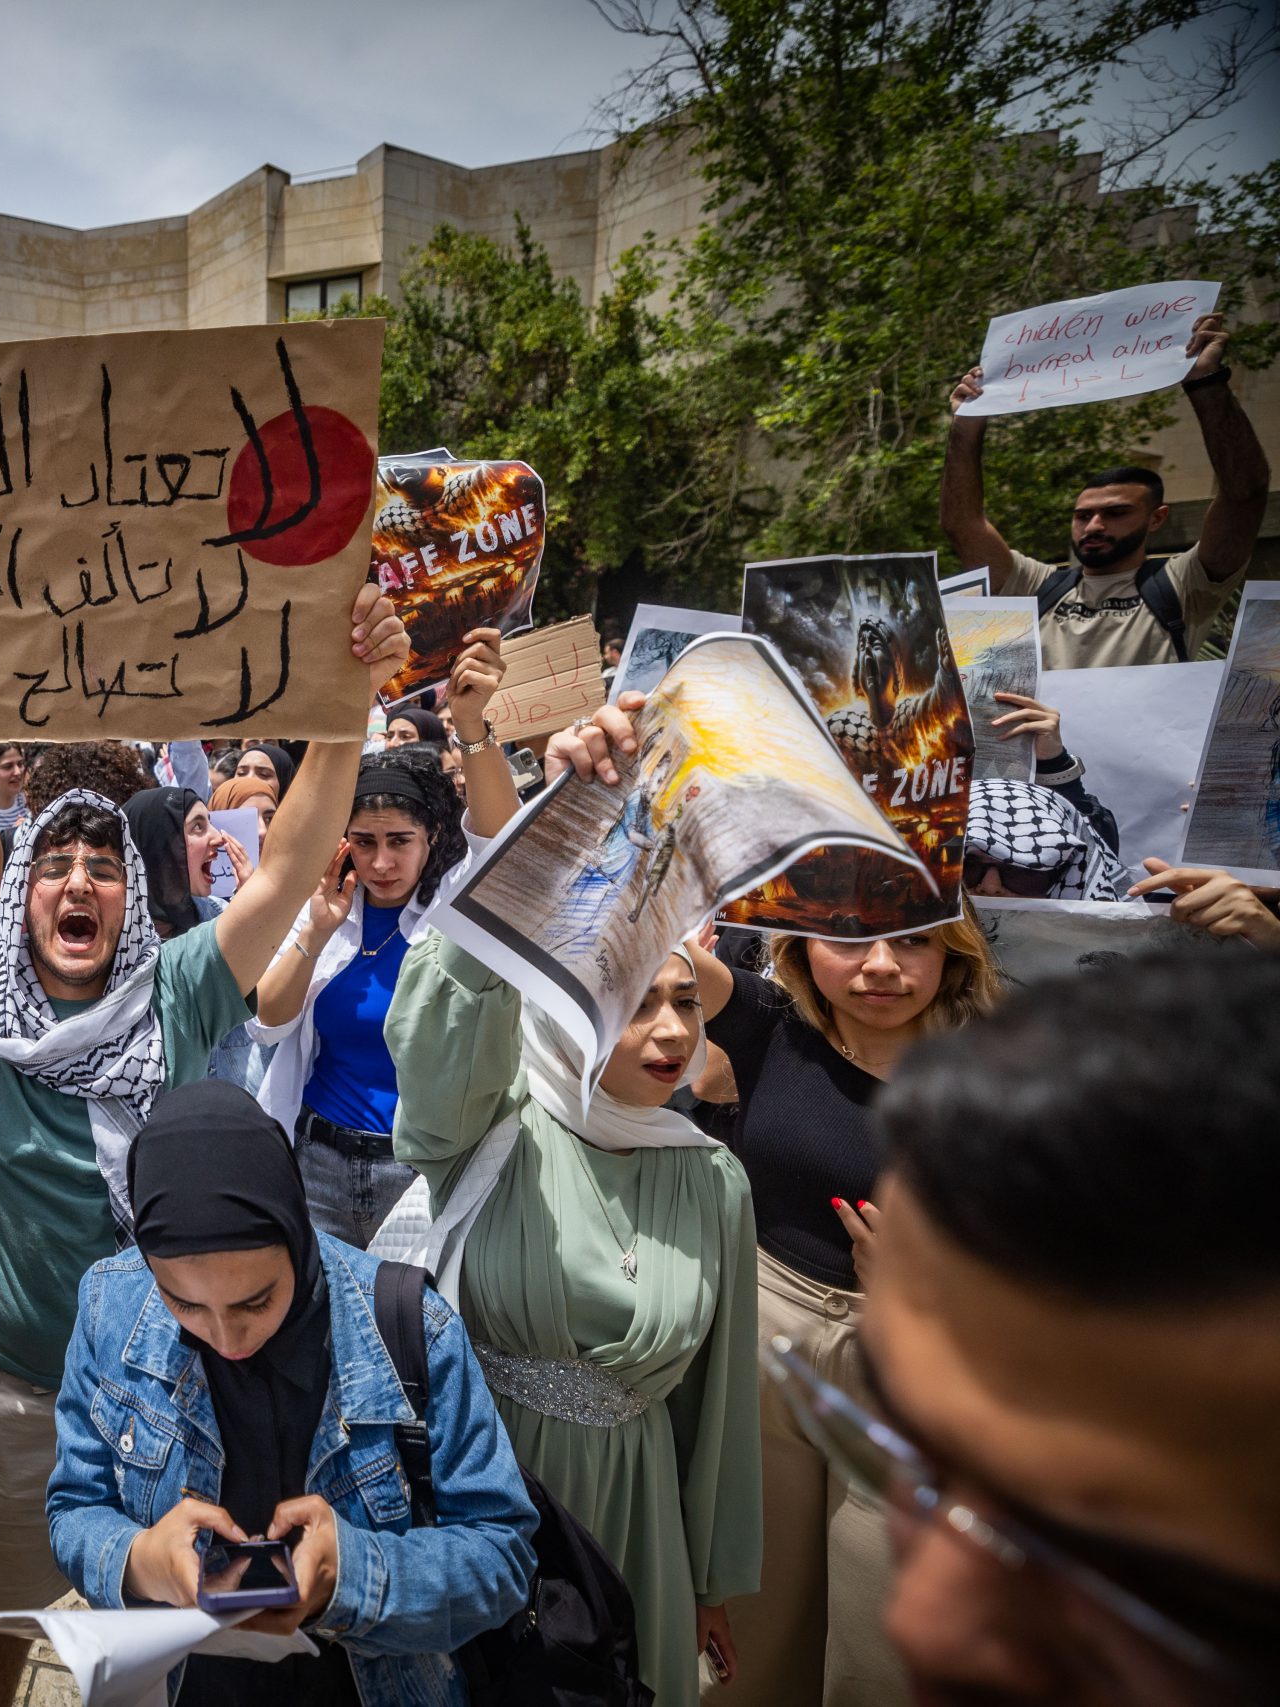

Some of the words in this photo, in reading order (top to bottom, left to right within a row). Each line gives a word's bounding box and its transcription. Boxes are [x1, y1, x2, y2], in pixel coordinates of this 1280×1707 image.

[1124, 296, 1197, 328] were
[1004, 343, 1095, 380] burned
[1112, 334, 1173, 360] alive
[201, 336, 322, 547] لا
[376, 542, 444, 596] AFE
[450, 503, 537, 564] ZONE
[171, 548, 249, 640] لا
[199, 600, 292, 727] لا
[542, 642, 579, 694] لا
[890, 757, 967, 808] ZONE
